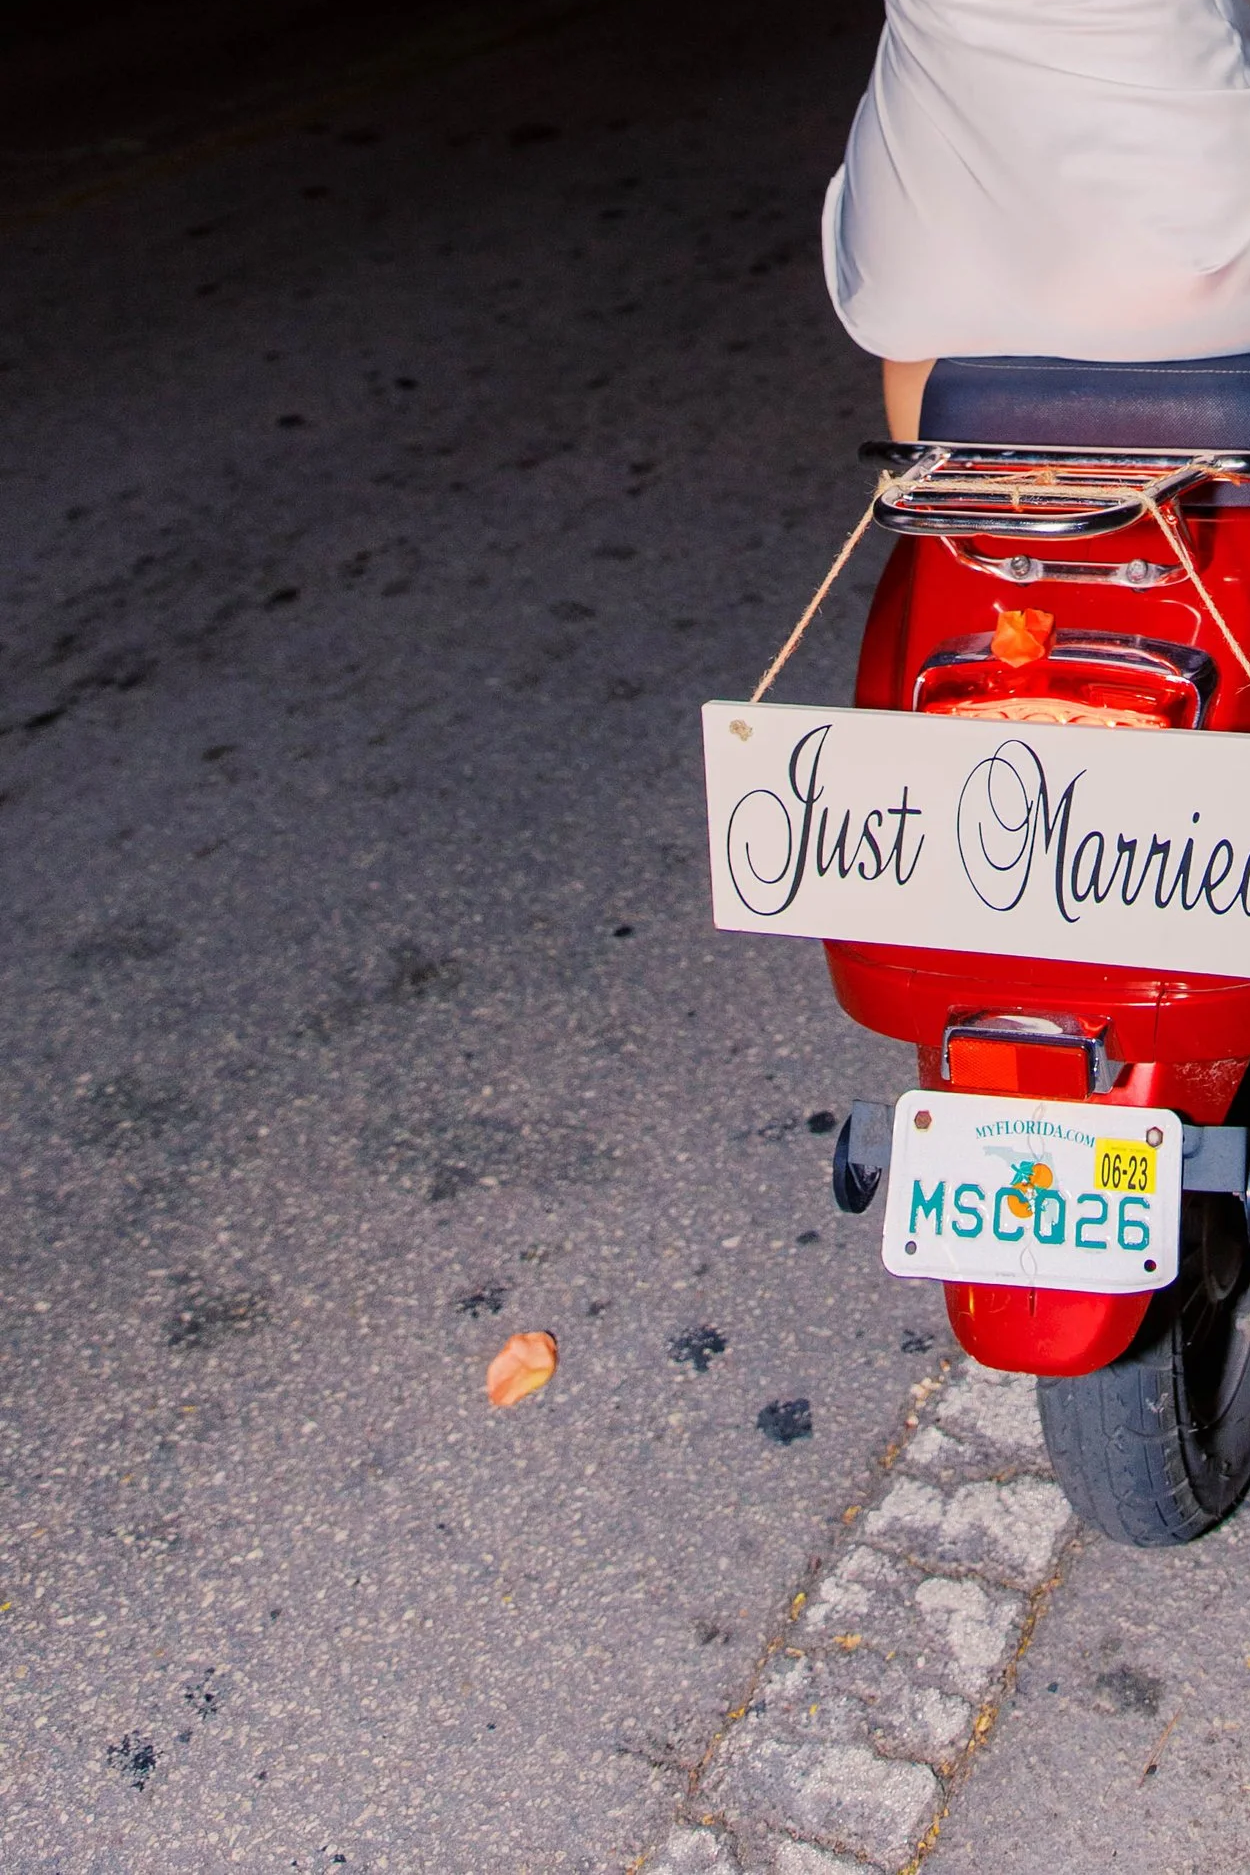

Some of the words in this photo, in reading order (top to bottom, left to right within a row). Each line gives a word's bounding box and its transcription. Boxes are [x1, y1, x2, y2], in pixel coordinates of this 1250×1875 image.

[728, 724, 925, 917] Just
[975, 1119, 1096, 1149] MYFLORIDA.COM
[1101, 1152, 1148, 1191] 06-23
[909, 1180, 1150, 1251] MSCQ26
